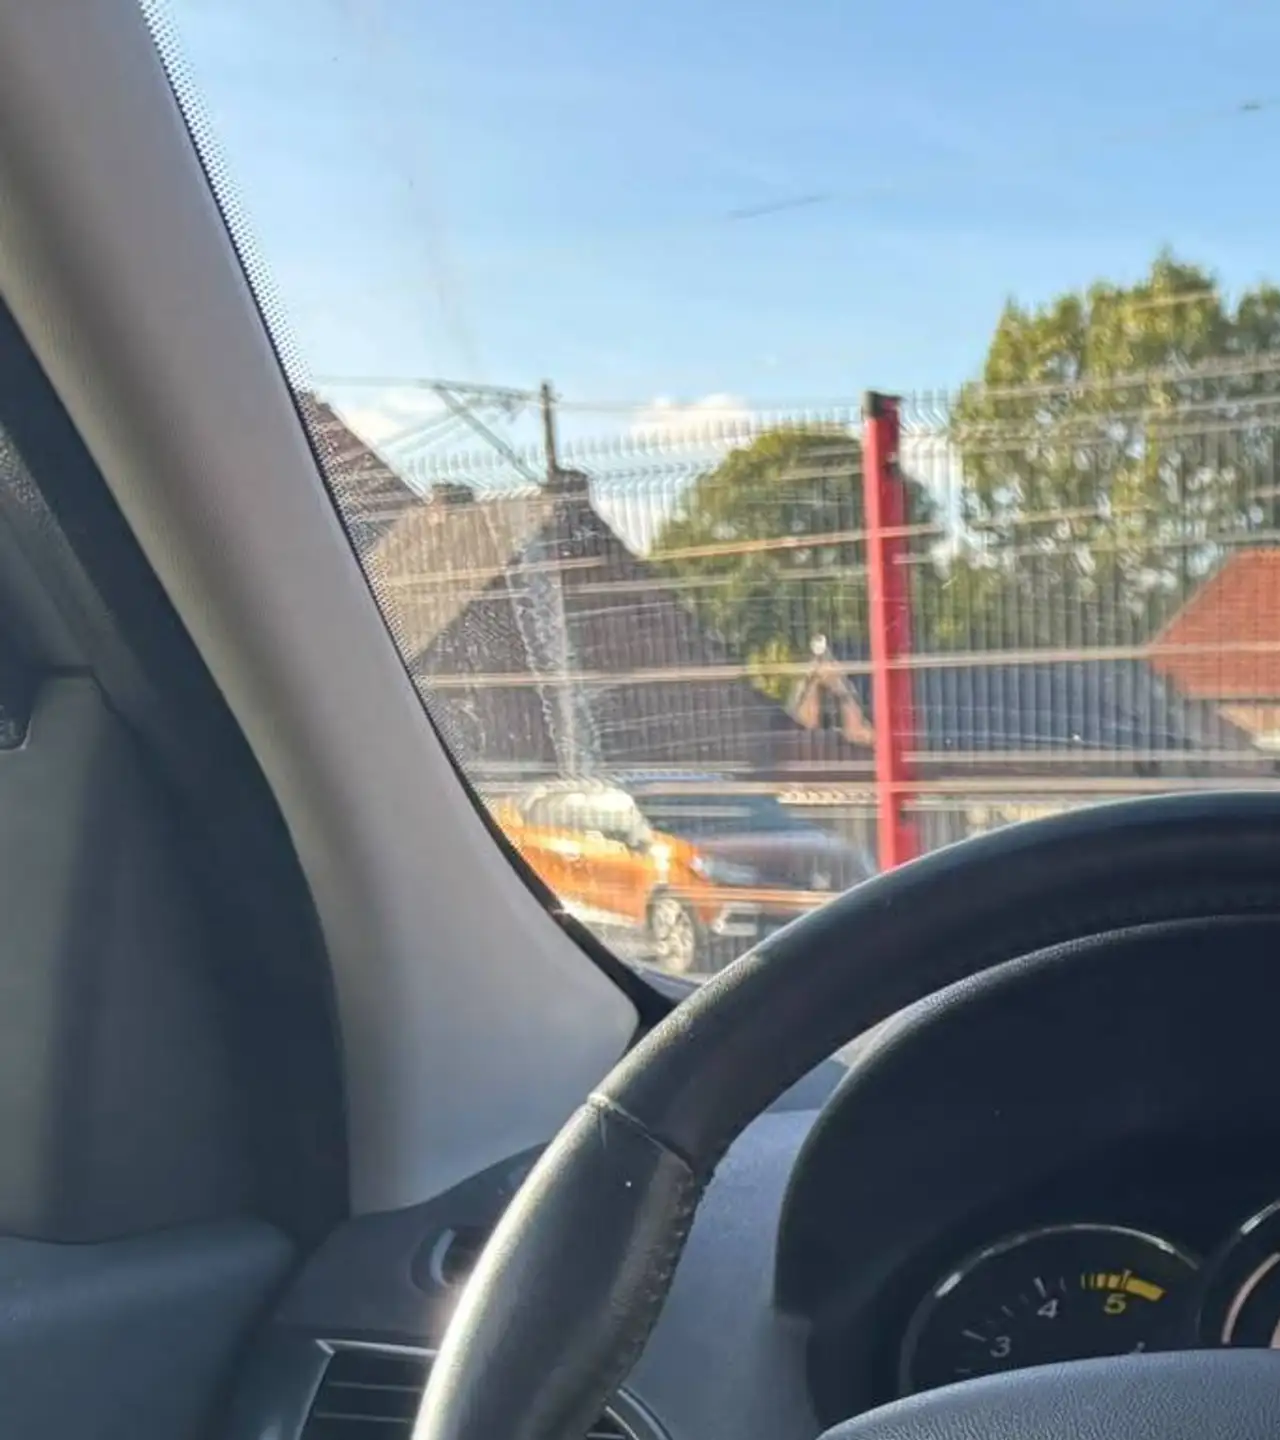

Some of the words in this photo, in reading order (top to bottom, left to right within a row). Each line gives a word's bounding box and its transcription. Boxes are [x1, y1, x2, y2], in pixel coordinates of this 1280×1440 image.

[1036, 1298, 1057, 1319] 4
[1104, 1294, 1126, 1315] 5
[990, 1336, 1011, 1358] 3
